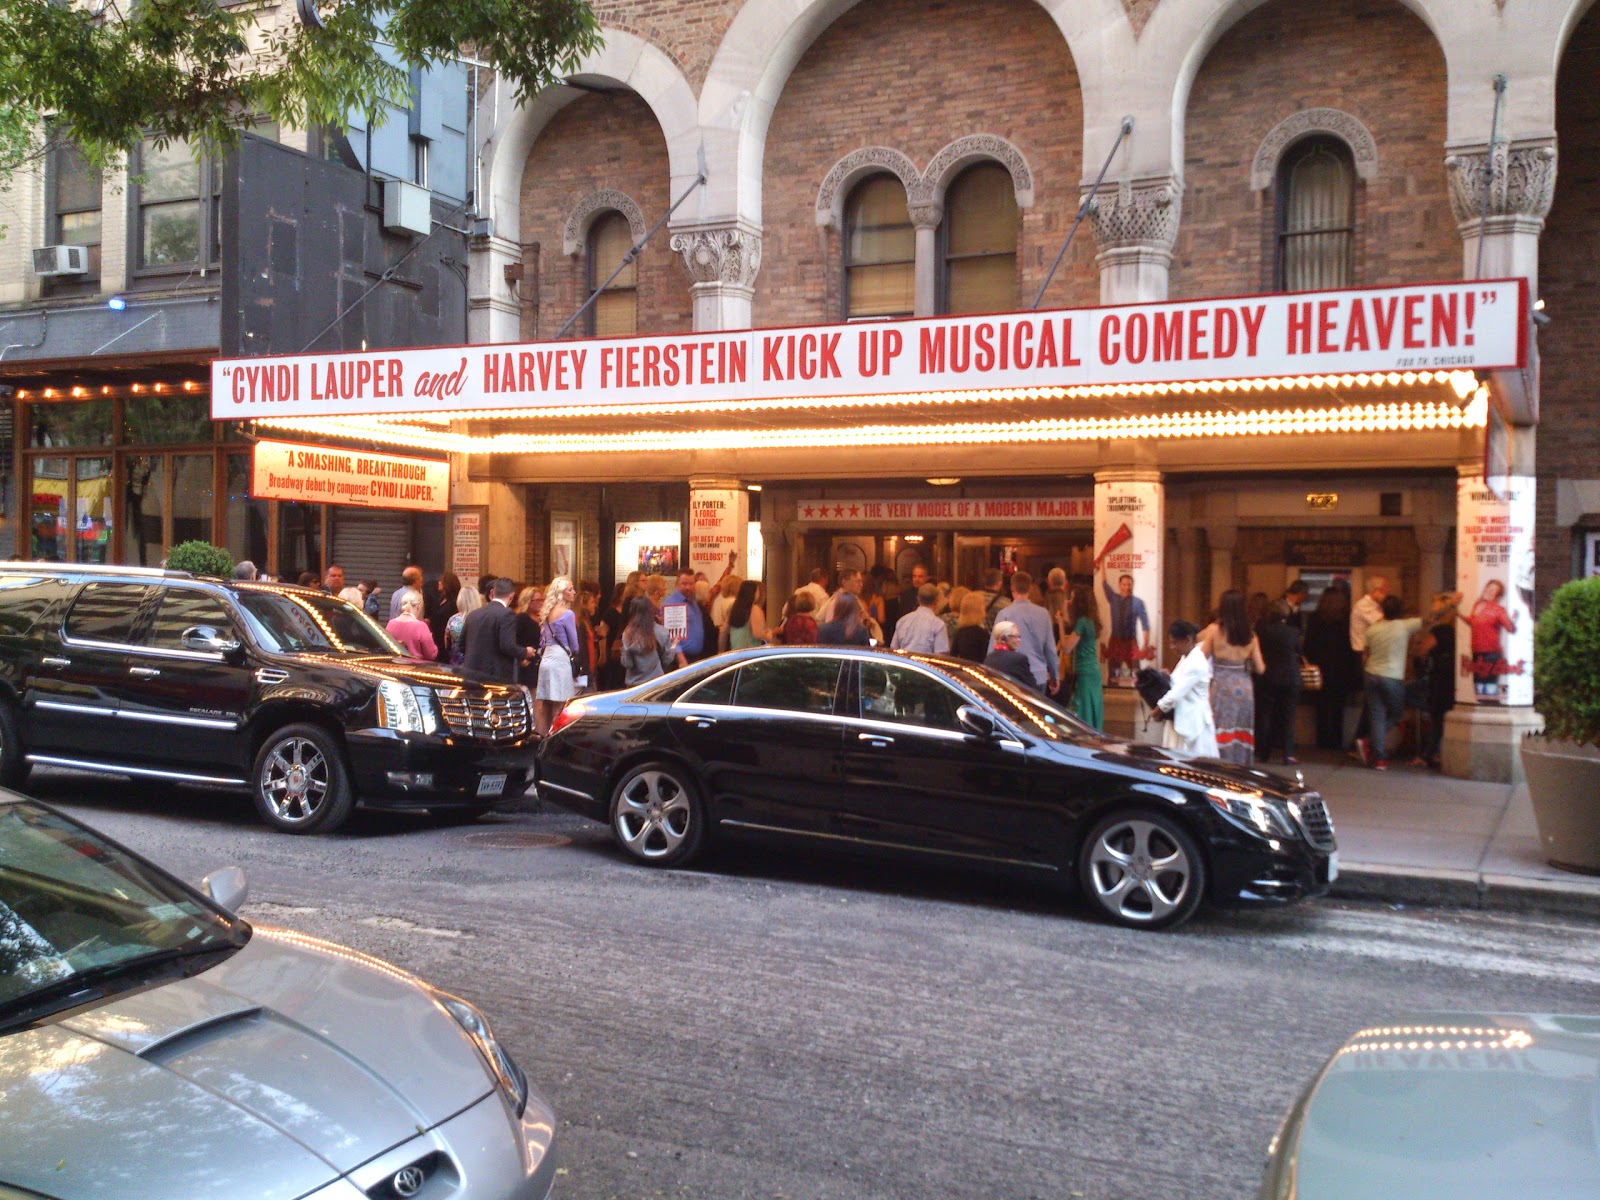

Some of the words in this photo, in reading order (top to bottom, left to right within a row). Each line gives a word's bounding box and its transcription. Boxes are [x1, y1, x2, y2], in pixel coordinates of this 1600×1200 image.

[311, 359, 403, 400] LAUPER
[414, 357, 468, 400] and
[484, 349, 587, 393] HARVEY
[601, 340, 747, 390] FIERSTEIN
[763, 332, 842, 381] KICK
[859, 329, 903, 378] UP
[920, 319, 1081, 374] MUSICAL
[1100, 308, 1266, 366] COMEDY
[297, 452, 354, 475] SMASHING,
[357, 458, 426, 481] BREAKTHROUGH
[269, 473, 303, 493] Broadway
[305, 477, 326, 492] debut
[328, 480, 335, 496] by
[336, 482, 369, 498] composer
[370, 480, 398, 499] CYNDI
[700, 510, 717, 518] FORCE
[863, 502, 882, 518] THE
[886, 502, 912, 518] VERY
[917, 502, 952, 517] MODEL
[957, 501, 971, 517] OF
[973, 502, 981, 517] A
[985, 501, 1032, 517] MODERN
[1036, 500, 1078, 517] MAJOR
